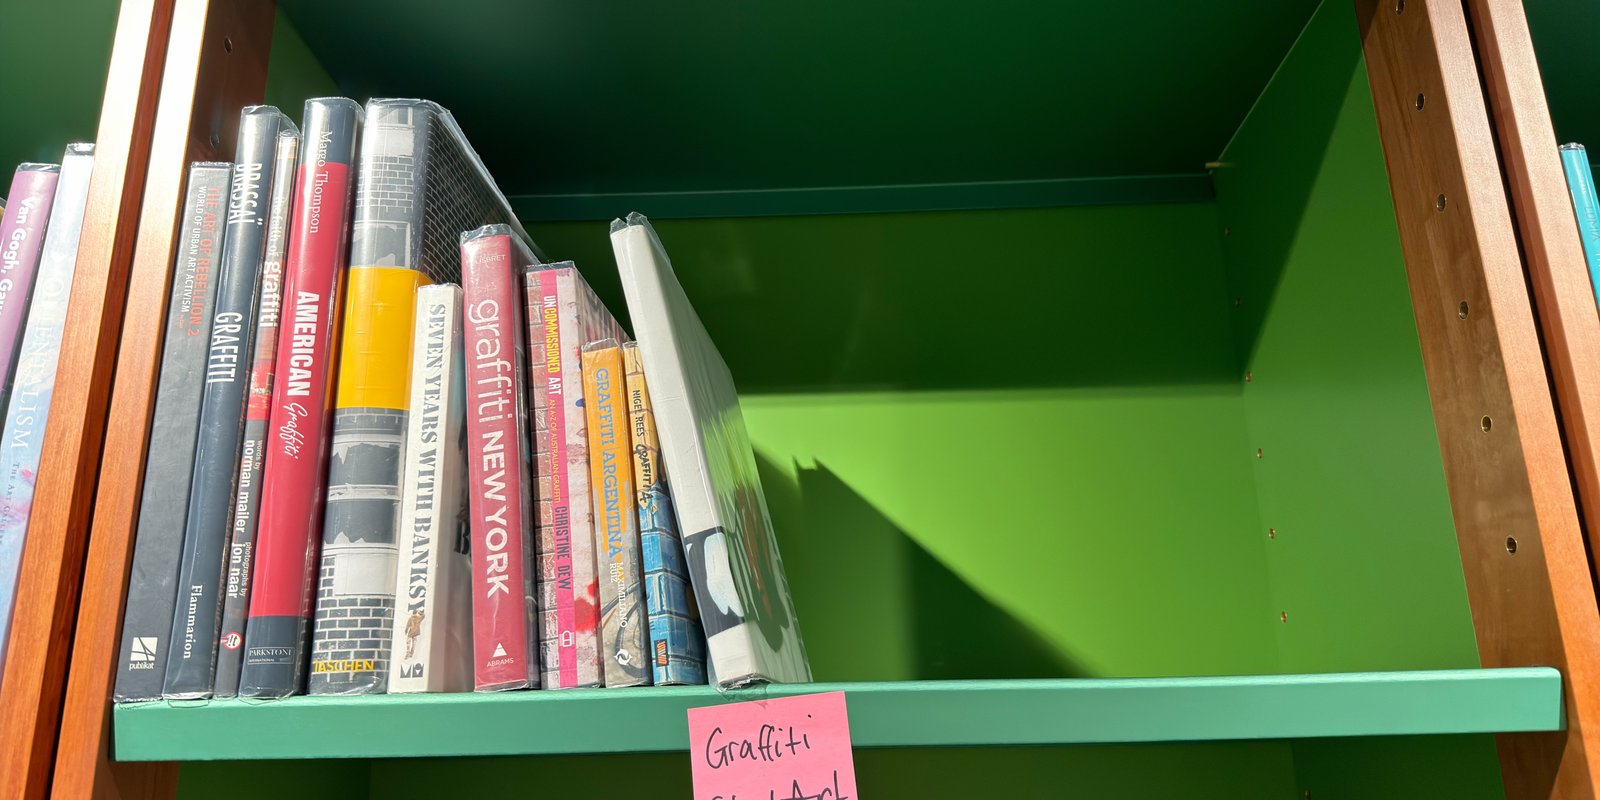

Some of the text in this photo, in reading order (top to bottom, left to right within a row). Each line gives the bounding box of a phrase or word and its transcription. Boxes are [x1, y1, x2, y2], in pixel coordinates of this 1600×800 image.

[196, 187, 207, 214] WORLD
[229, 163, 263, 226] BRASSAÏ
[309, 131, 333, 234] Margo Thompson
[16, 197, 34, 223] Van
[194, 216, 202, 225] OF
[1, 228, 26, 274] Gogh,
[187, 257, 198, 272] ART
[188, 188, 220, 336] THE ART OF REBELLION 2
[190, 228, 201, 255] URBAN
[181, 274, 194, 312] ACTIVISM
[260, 260, 282, 327] graffiti
[207, 312, 243, 383] GRAFFITI
[543, 295, 562, 395] UNCOMMISSIONED ART
[279, 291, 320, 460] AMERICAN Graffiti
[549, 399, 555, 409] AN
[550, 422, 557, 432] OF
[633, 390, 645, 437] NIGEL REES
[253, 463, 261, 471] by
[408, 304, 446, 614] SEVEN YEARS WITH BANKSY
[468, 300, 512, 598] graffiti NEW YORK
[551, 433, 559, 474] AUSTRALIAN
[596, 368, 623, 558] GRAFFITI ARGENTINA
[635, 444, 652, 491] GRAFFITI
[236, 440, 255, 533] norman mailer
[553, 475, 561, 503] GRAFFITI
[228, 542, 246, 598] jon naar
[239, 542, 252, 597] photographs by
[555, 506, 571, 590] CHRISTINE DEW
[617, 562, 627, 628] MAXIMILIANO
[183, 584, 203, 660] Flammarion
[249, 648, 292, 657] PARKSTONE
[313, 659, 374, 673] TASCHEN
[487, 658, 514, 668] ABRAMS
[706, 714, 812, 769] Graffiti
